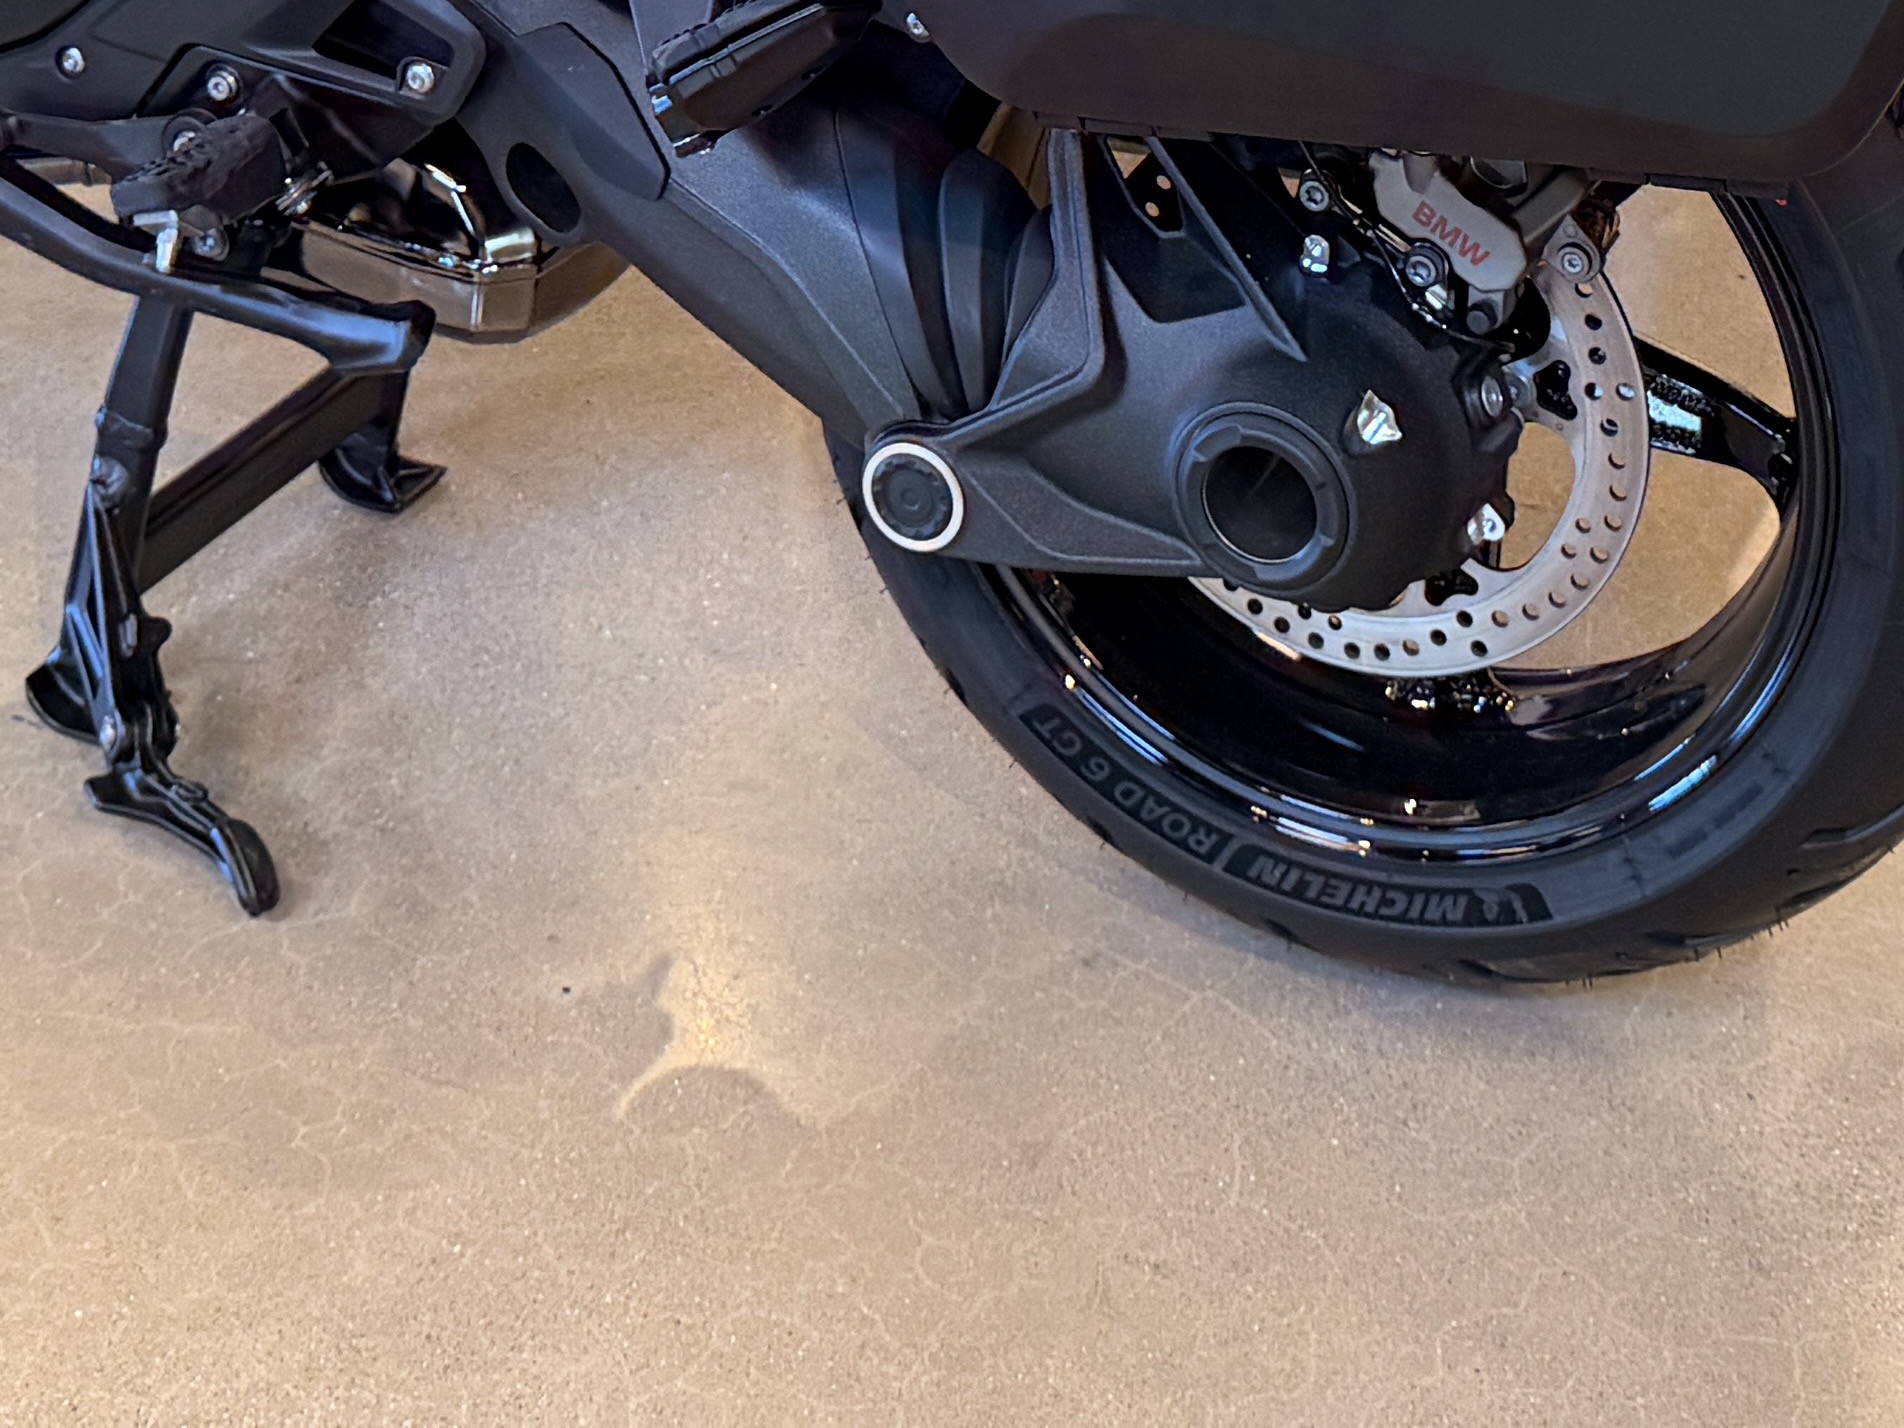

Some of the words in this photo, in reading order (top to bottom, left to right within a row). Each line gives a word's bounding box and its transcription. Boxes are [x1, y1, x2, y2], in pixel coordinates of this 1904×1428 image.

[1412, 199, 1491, 266] BMW
[1031, 715, 1084, 757] GT
[1079, 755, 1112, 783] 6
[1112, 779, 1221, 855] ROAD
[1246, 854, 1470, 923] MICHELIN
